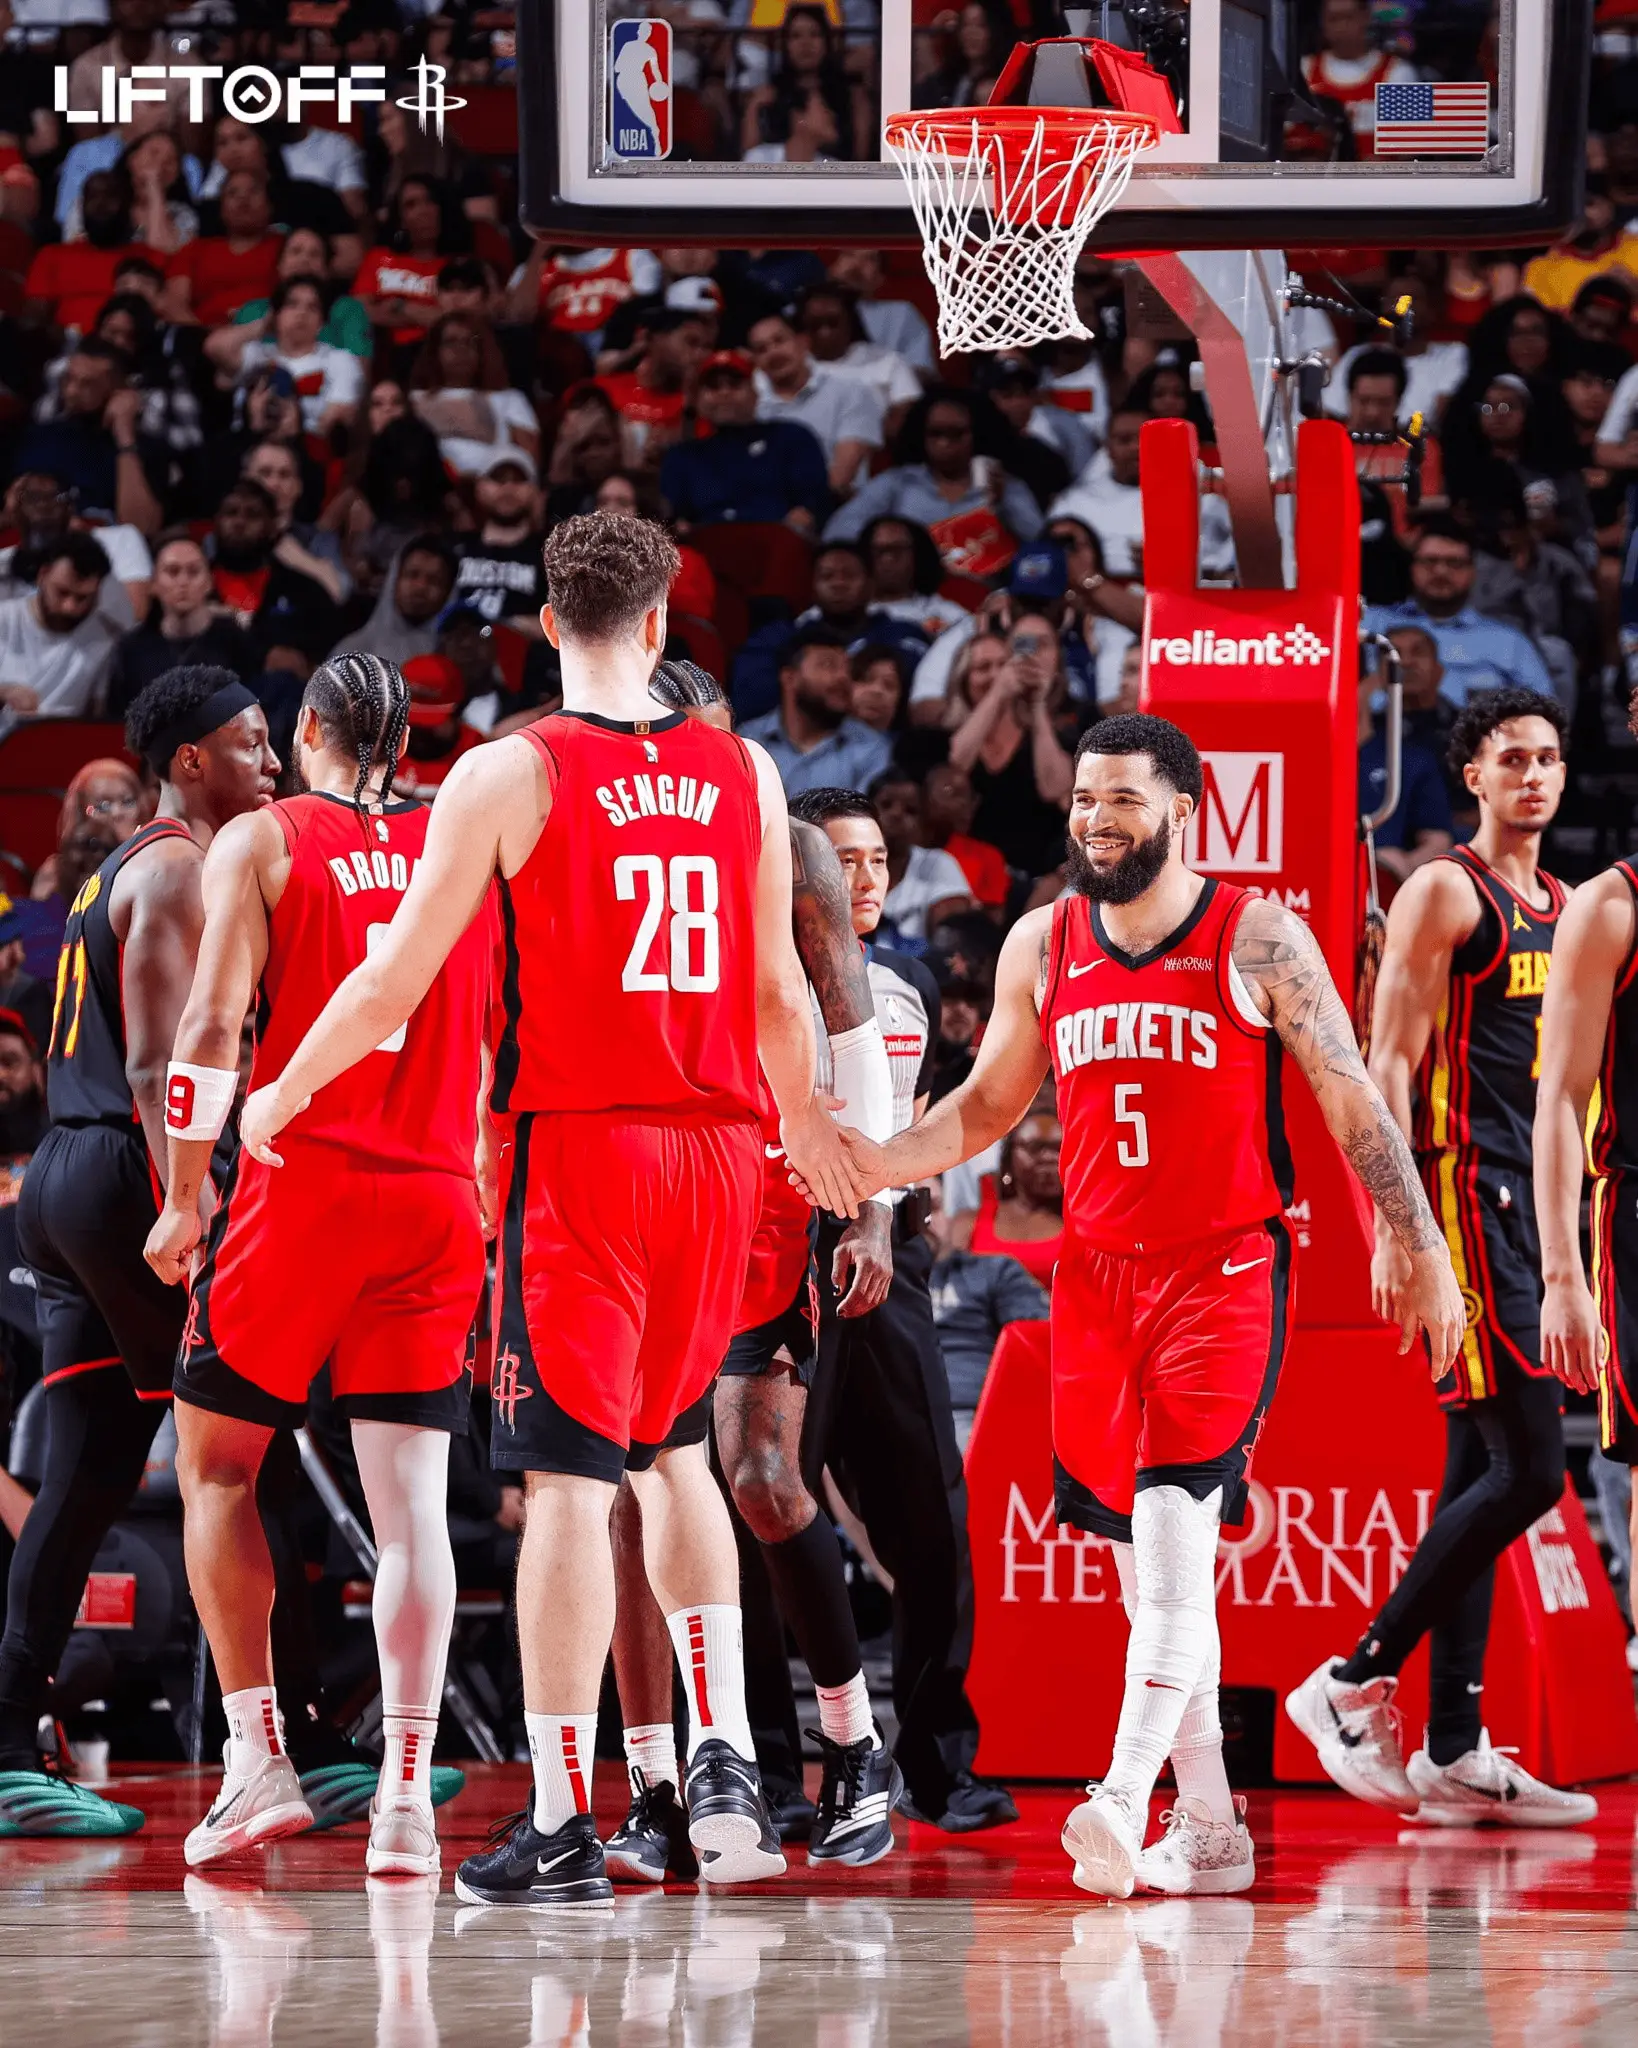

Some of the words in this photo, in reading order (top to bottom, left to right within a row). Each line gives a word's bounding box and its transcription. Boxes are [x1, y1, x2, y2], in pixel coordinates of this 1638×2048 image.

[620, 129, 648, 151] NBA
[1150, 629, 1285, 666] reliant
[595, 773, 721, 827] SENGUN
[1195, 760, 1272, 863] M
[329, 850, 421, 896] BROO
[613, 854, 720, 993] 28
[1164, 956, 1213, 966] MEMORIAL
[884, 1038, 921, 1053] mirates
[1055, 1002, 1218, 1077] ROCKETS
[166, 1074, 196, 1130] 9
[1114, 1083, 1150, 1168] 5
[999, 1478, 1435, 1560] MORIAL
[999, 1539, 1410, 1609] HEAN
